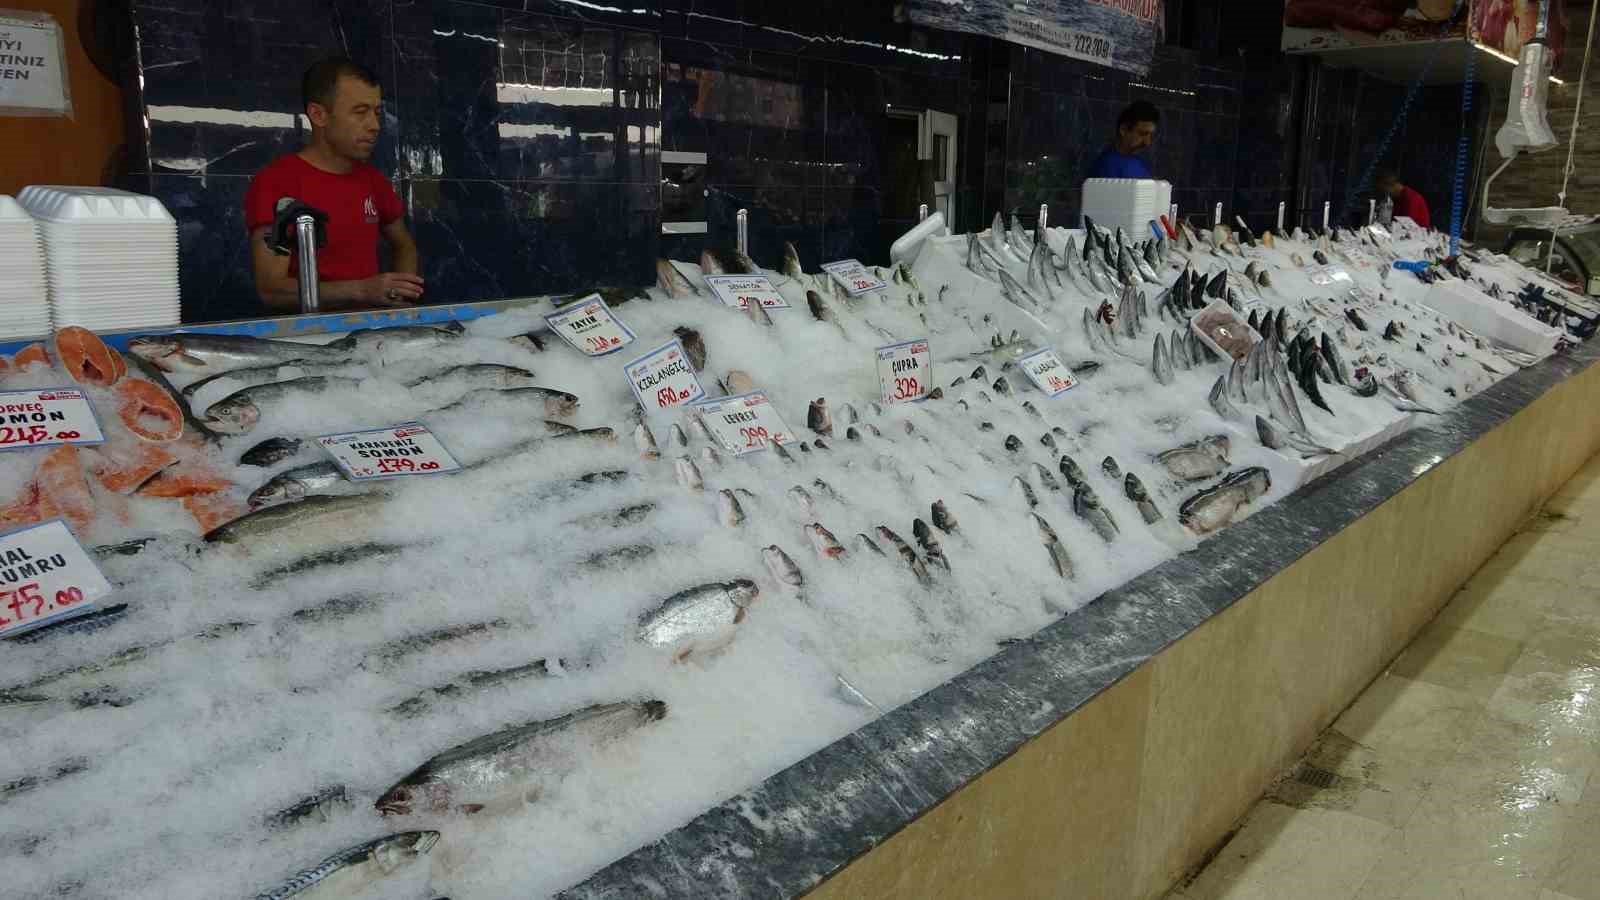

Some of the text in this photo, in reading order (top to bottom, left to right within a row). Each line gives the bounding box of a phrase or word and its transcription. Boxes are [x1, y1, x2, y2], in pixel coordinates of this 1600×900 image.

[568, 315, 597, 330] YAYIN
[722, 410, 758, 424] LEVREK
[357, 446, 424, 458] SOMON
[376, 458, 439, 473] 179.00
[0, 553, 67, 585] UMRU
